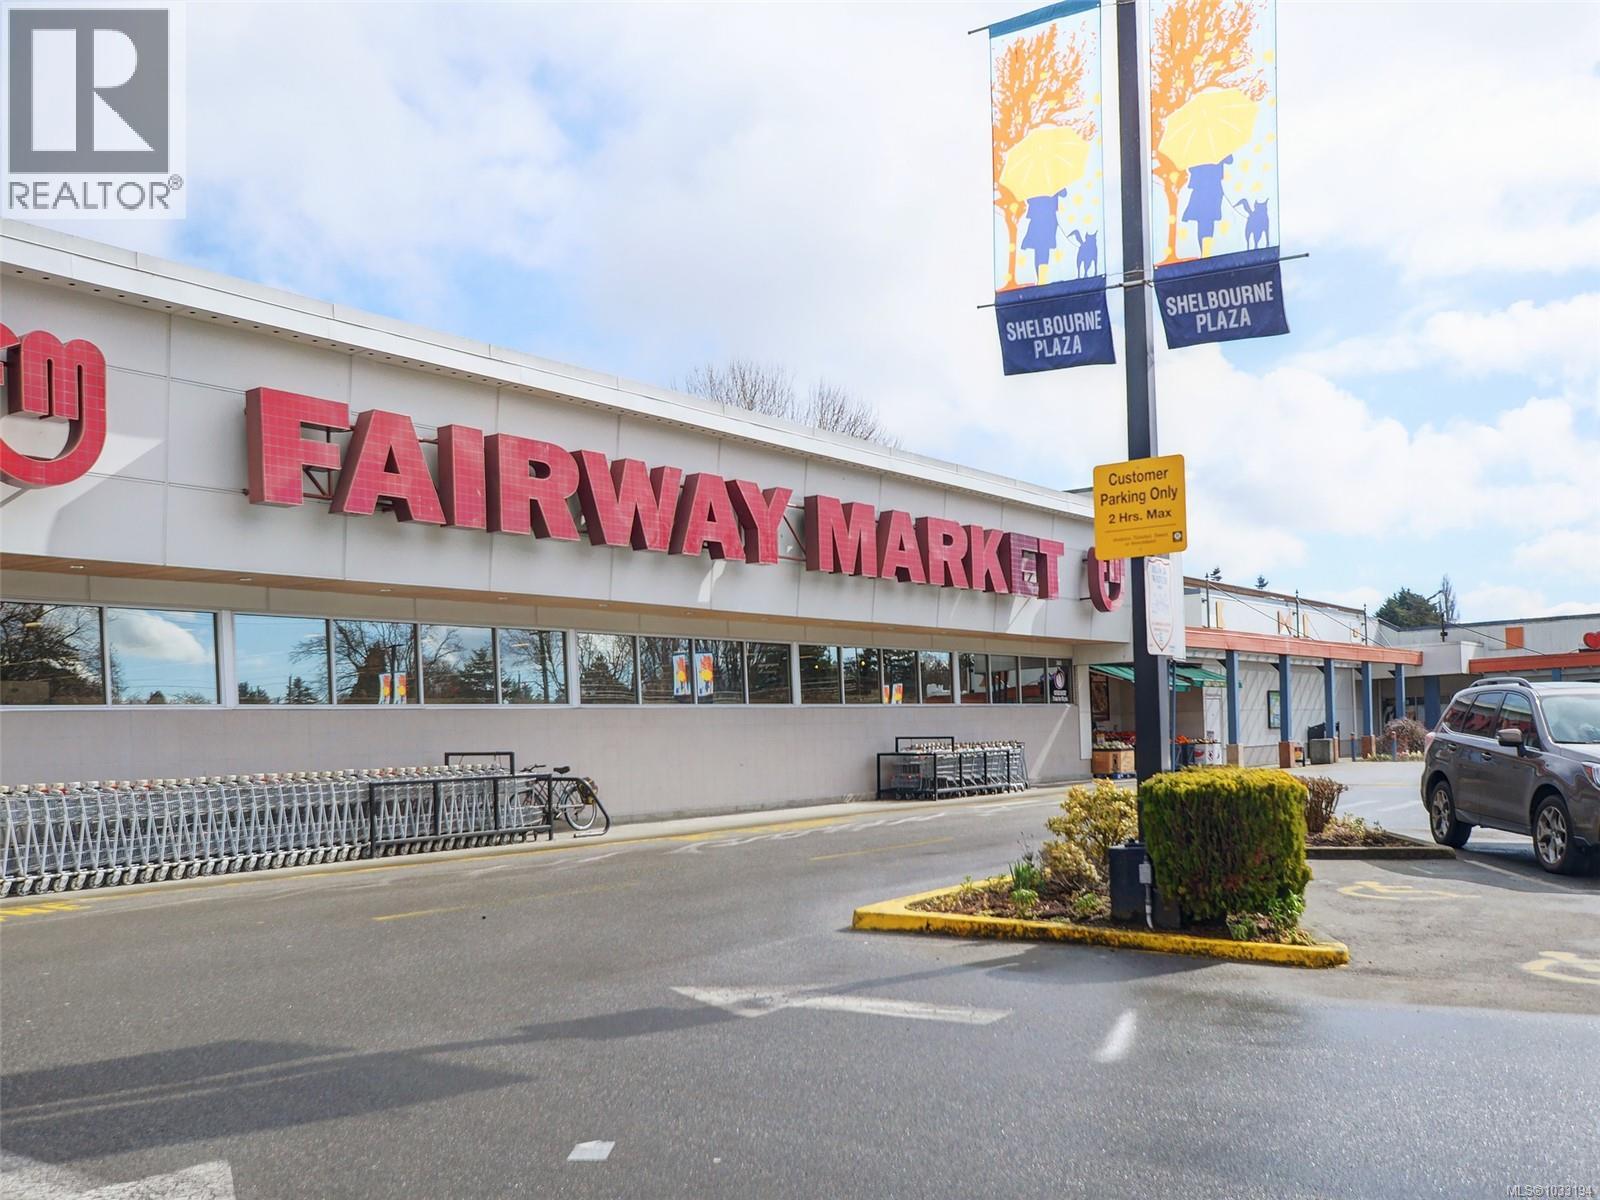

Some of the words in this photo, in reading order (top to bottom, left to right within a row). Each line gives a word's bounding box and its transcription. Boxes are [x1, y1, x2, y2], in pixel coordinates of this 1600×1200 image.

[1166, 281, 1274, 316] SHELBOURNE
[1006, 310, 1102, 341] SHELBOURNE
[1195, 308, 1251, 334] PLAZA
[1034, 336, 1082, 359] PLAZA
[1108, 469, 1169, 486] Customer
[246, 387, 793, 565] FAIRWAY
[804, 494, 1065, 600] MARKET
[1100, 490, 1147, 507] Parking
[1150, 486, 1178, 502] Only
[1108, 513, 1116, 524] 2
[1119, 511, 1143, 524] Hrs.
[1146, 508, 1172, 520] Max
